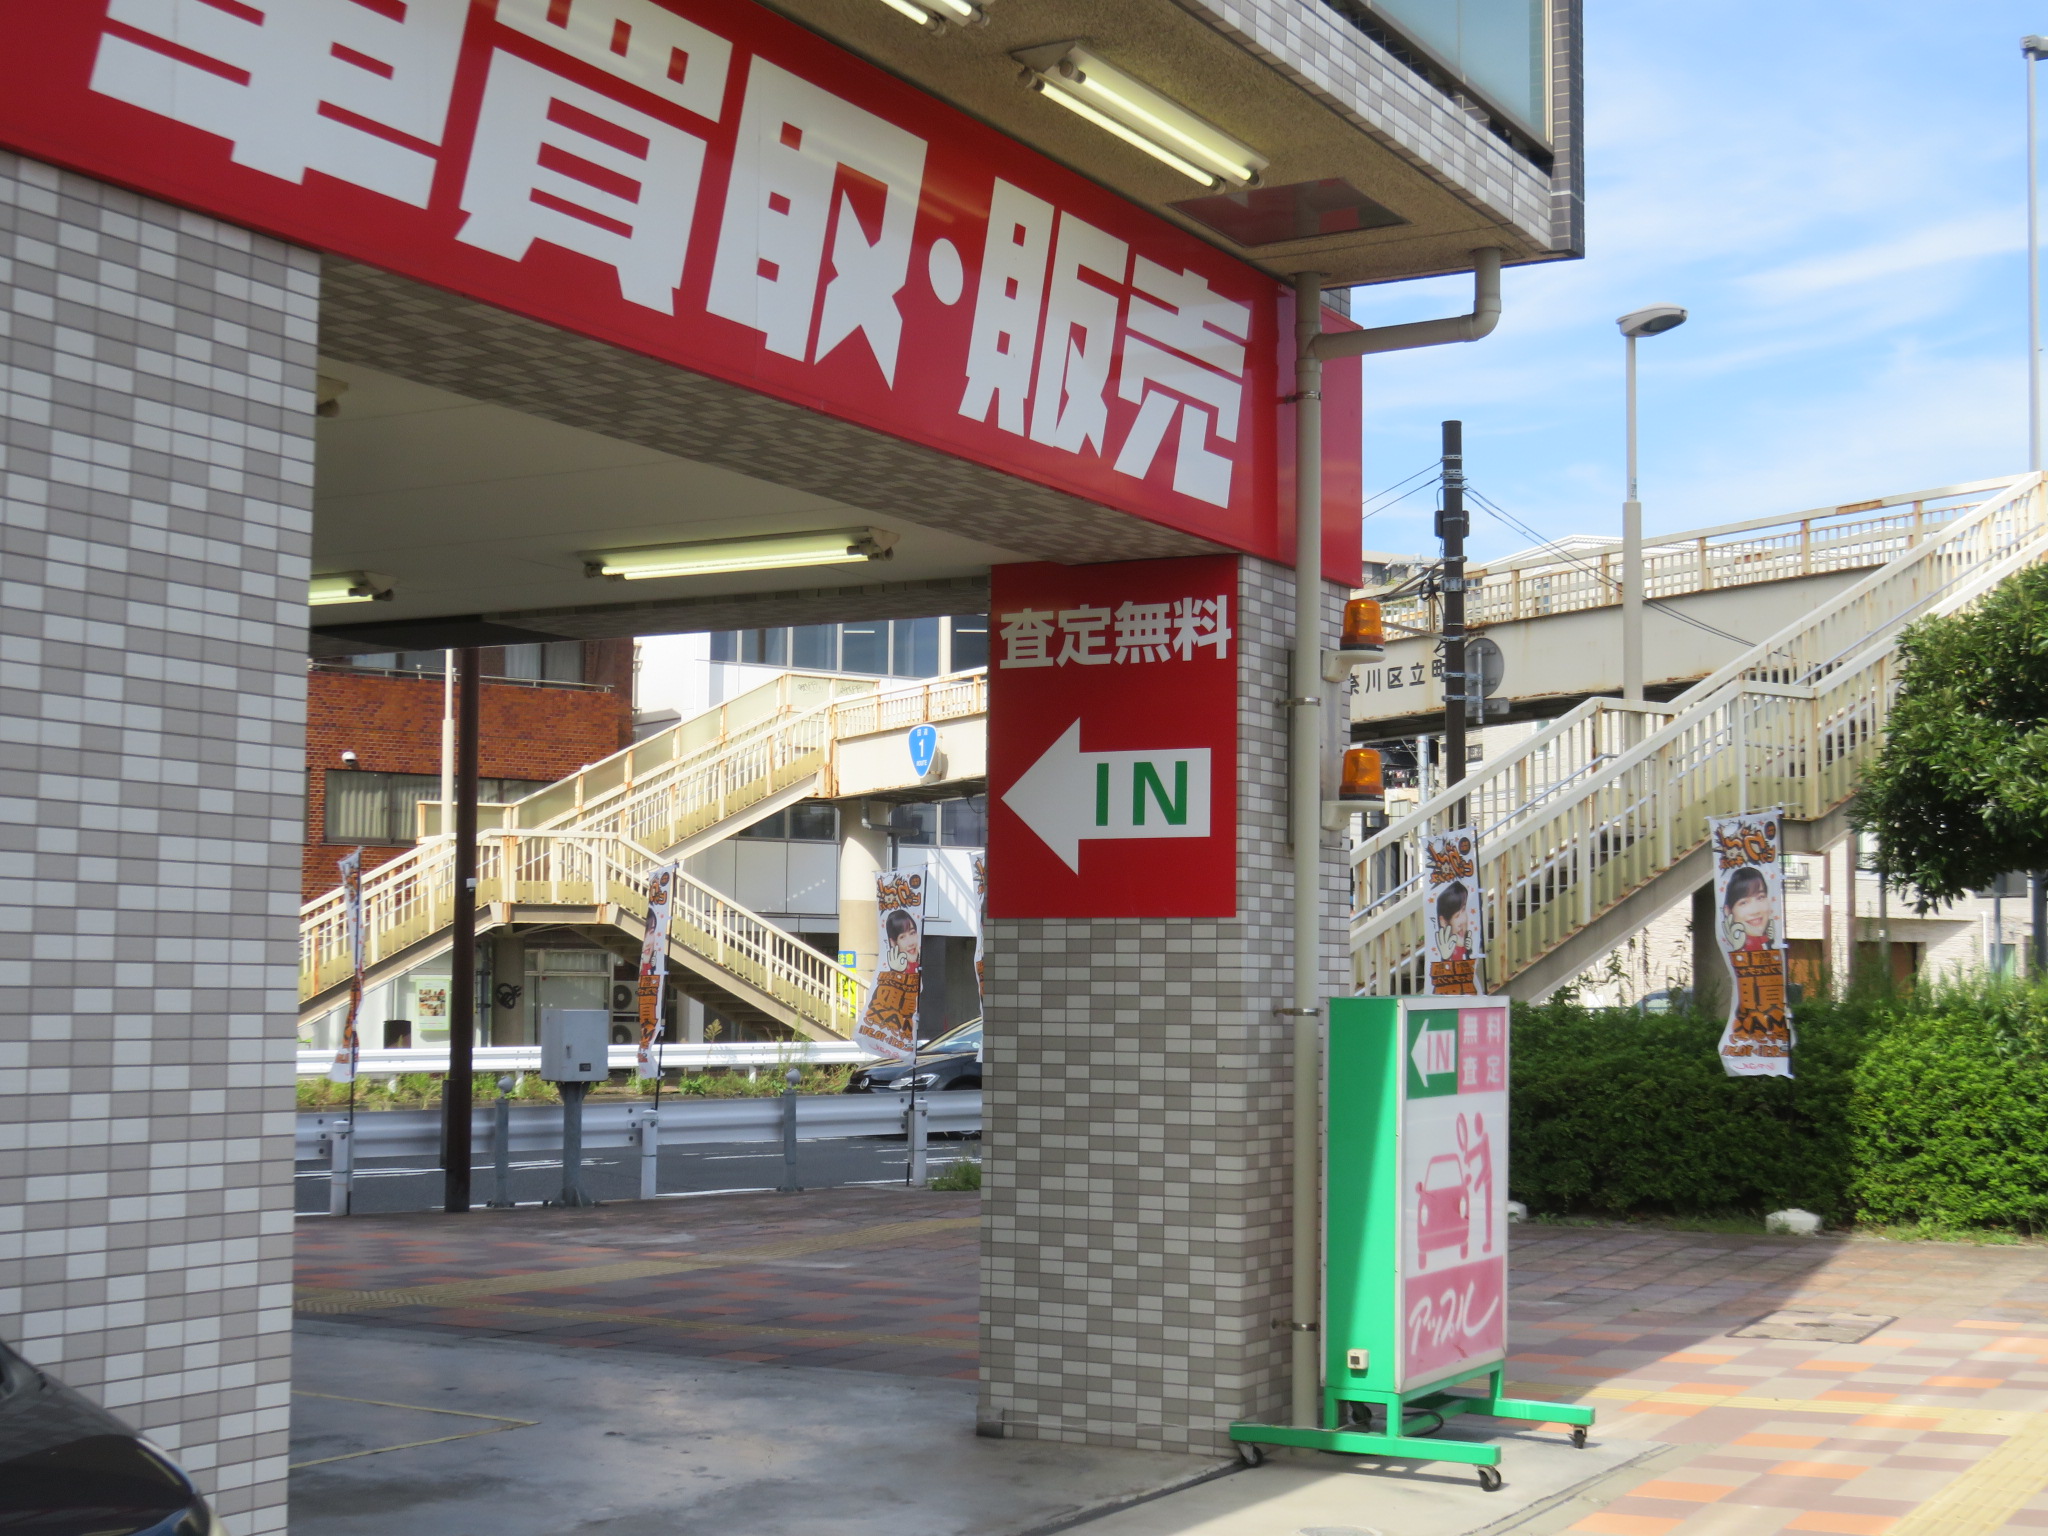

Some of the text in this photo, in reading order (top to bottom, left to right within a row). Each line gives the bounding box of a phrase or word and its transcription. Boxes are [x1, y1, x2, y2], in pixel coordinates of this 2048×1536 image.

[1000, 595, 1232, 670] 査定無料
[918, 738, 925, 758] 1
[1095, 760, 1188, 827] IN
[1463, 1013, 1501, 1045] 無料
[1426, 1033, 1452, 1073] IN
[1463, 1055, 1501, 1087] 査定
[1408, 1279, 1500, 1357] アップル
